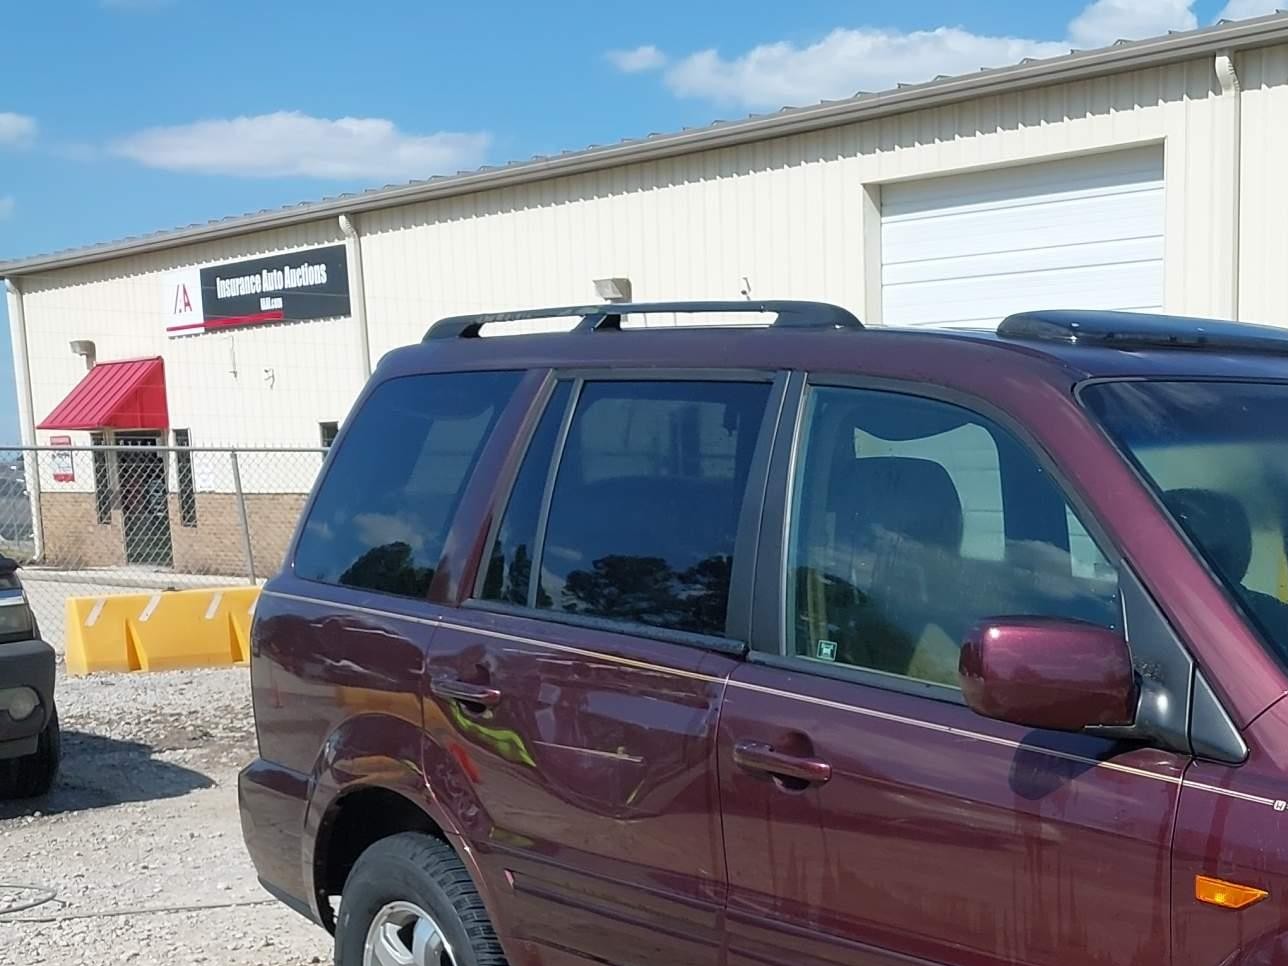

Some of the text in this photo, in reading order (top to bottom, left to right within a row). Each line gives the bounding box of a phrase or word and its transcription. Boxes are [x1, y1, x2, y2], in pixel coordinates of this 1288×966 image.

[216, 262, 327, 299] Insurance Auto Auctions
